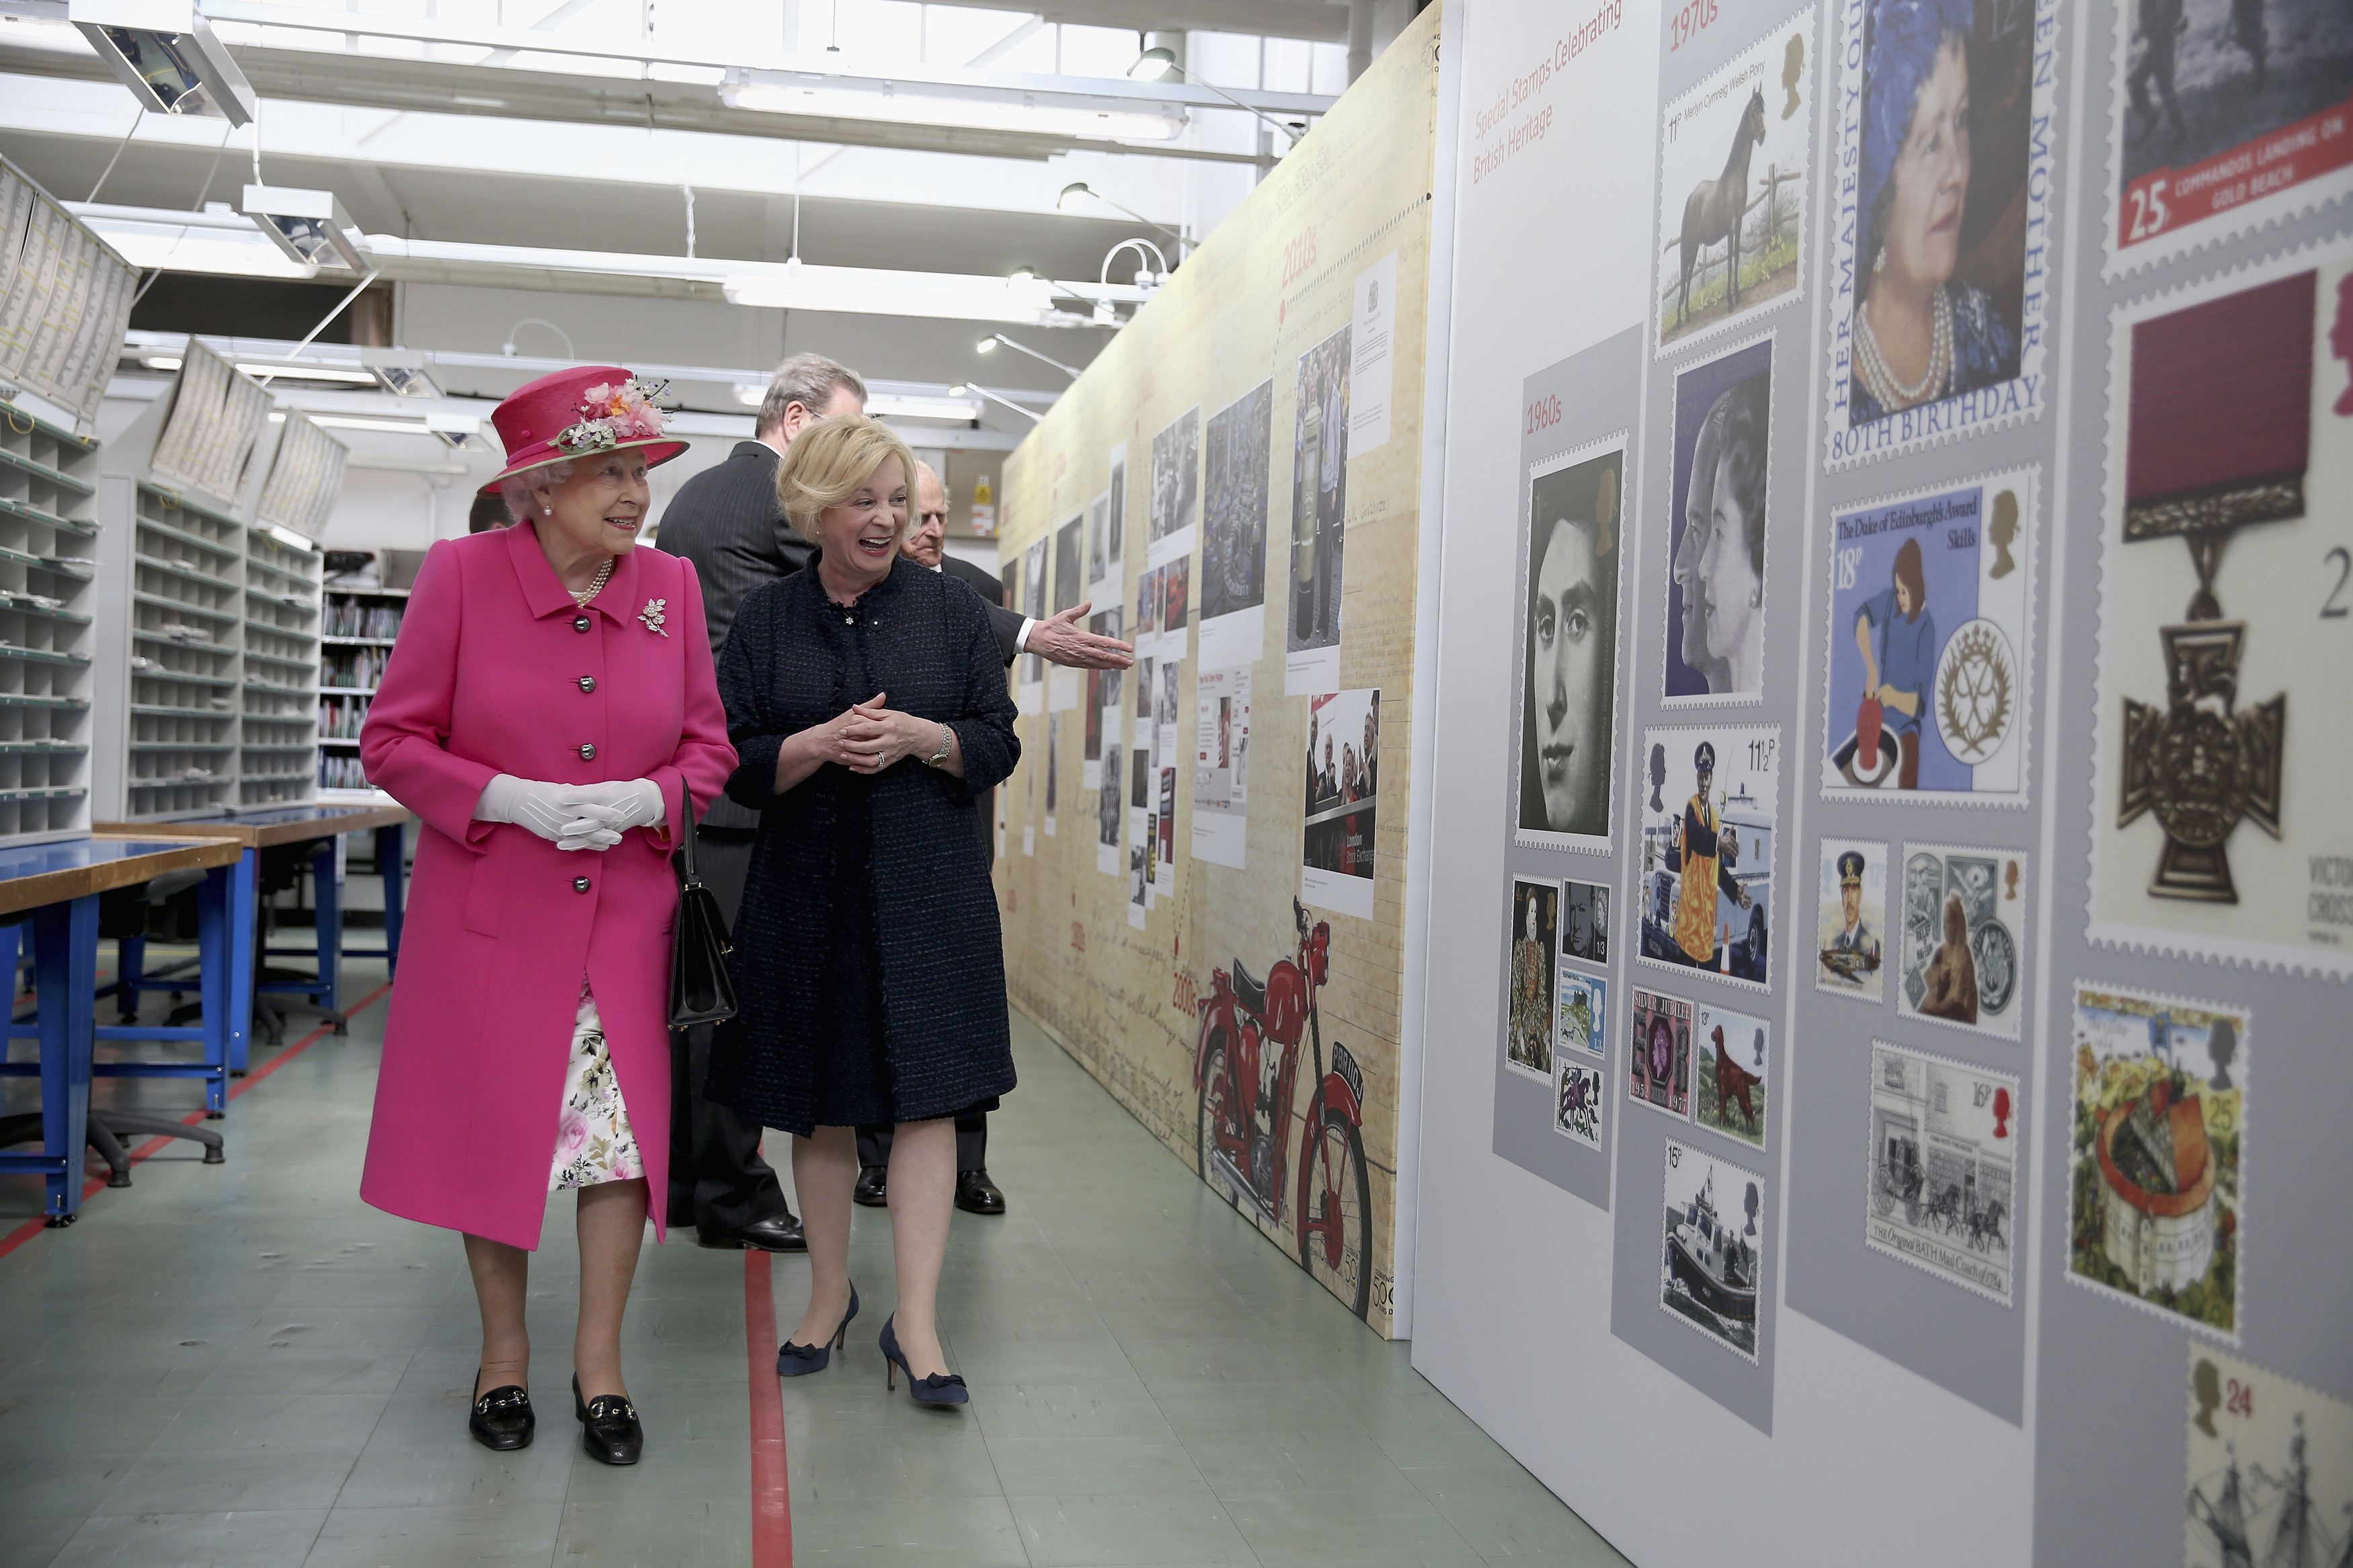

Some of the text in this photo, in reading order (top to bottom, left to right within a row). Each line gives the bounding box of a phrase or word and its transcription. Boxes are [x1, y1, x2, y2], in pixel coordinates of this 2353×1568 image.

[1670, 0, 1718, 52] 1970s
[1475, 0, 1622, 142] Special Stamps Celebrating
[1685, 101, 1703, 121] Merlyn
[1704, 82, 1728, 108] Cymreig
[1730, 69, 1748, 92] Welsh
[1749, 60, 1766, 81] Pony
[1474, 105, 1552, 185] British Heritage
[2174, 114, 2345, 198] COMMANDOS LANDING ON
[1839, 85, 1860, 299] MAJESTY
[2128, 178, 2167, 242] 25
[2210, 164, 2295, 210] GOLD BEACH
[1282, 225, 1316, 289] 2010s
[2023, 114, 2049, 362] MOTHER
[1835, 308, 1850, 412] HER
[1527, 395, 1561, 435] 1960s
[1901, 377, 2037, 442] BIRTHDAY
[1837, 522, 1853, 540] The
[1856, 516, 1878, 538] Duke
[1879, 513, 1889, 534] of
[1944, 495, 1977, 521] Award
[1947, 527, 1977, 550] Skills
[1347, 833, 1362, 848] London
[1172, 972, 1196, 1019] 2000s
[1634, 993, 1691, 1020] SILVER JUBILEE
[1631, 1081, 1687, 1112] 1952 1977
[2209, 1096, 2233, 1132] 25
[1874, 1225, 1887, 1239] THE
[1888, 1228, 1915, 1249] Original
[1915, 1241, 1938, 1260] BATH
[1939, 1248, 1955, 1268] Mail
[1956, 1256, 1978, 1278] Coach
[1979, 1268, 1987, 1284] of
[2227, 1378, 2253, 1419] 24
